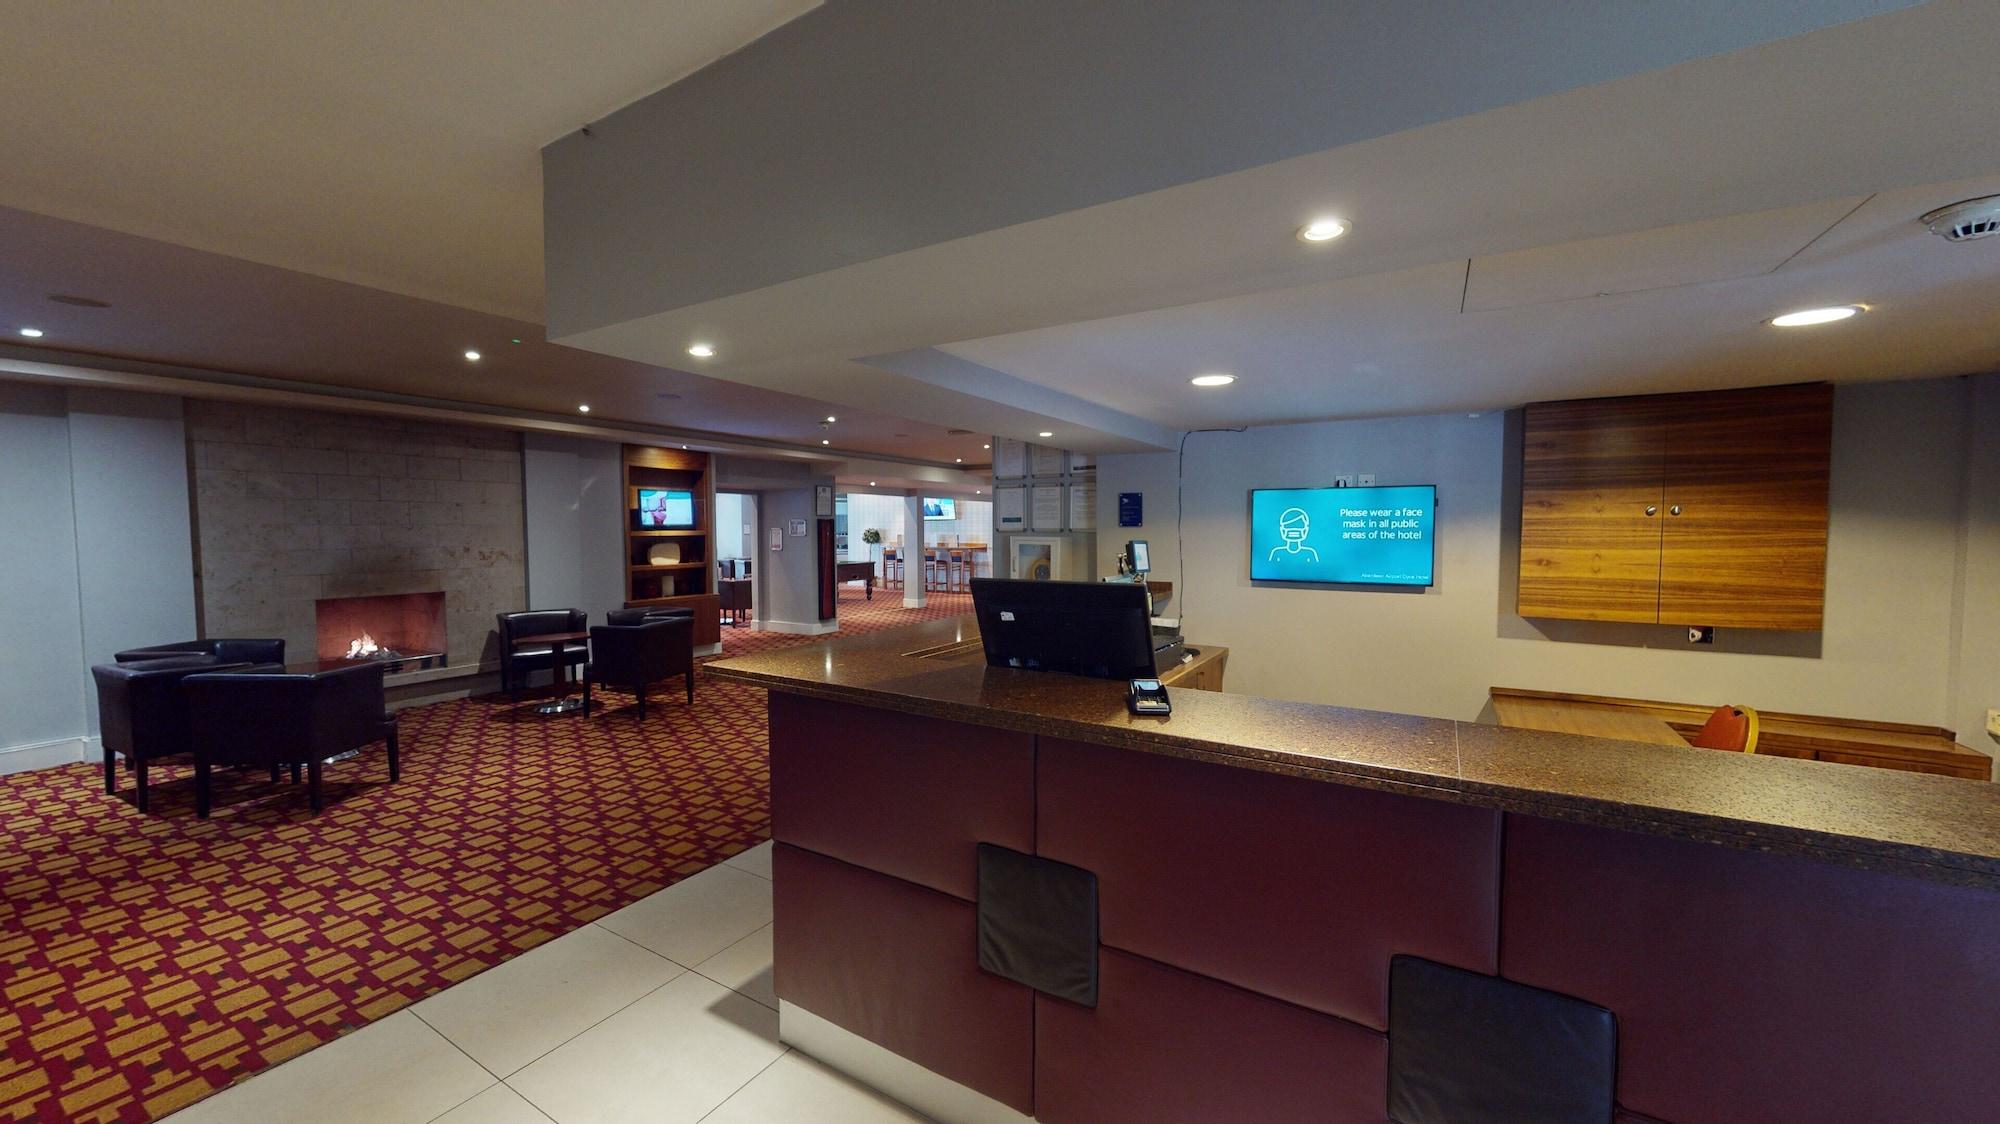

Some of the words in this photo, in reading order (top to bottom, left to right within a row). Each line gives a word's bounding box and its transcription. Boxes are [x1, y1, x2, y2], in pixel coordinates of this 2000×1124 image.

[1340, 508, 1367, 517] Please
[1395, 509, 1401, 517] a
[1402, 507, 1423, 517] face
[1343, 519, 1366, 528] mask
[1368, 519, 1377, 528] in
[1379, 519, 1389, 528] all
[1391, 519, 1419, 529] public
[1368, 530, 1378, 539] of
[1380, 530, 1395, 539] the
[1398, 530, 1422, 539] hotel
